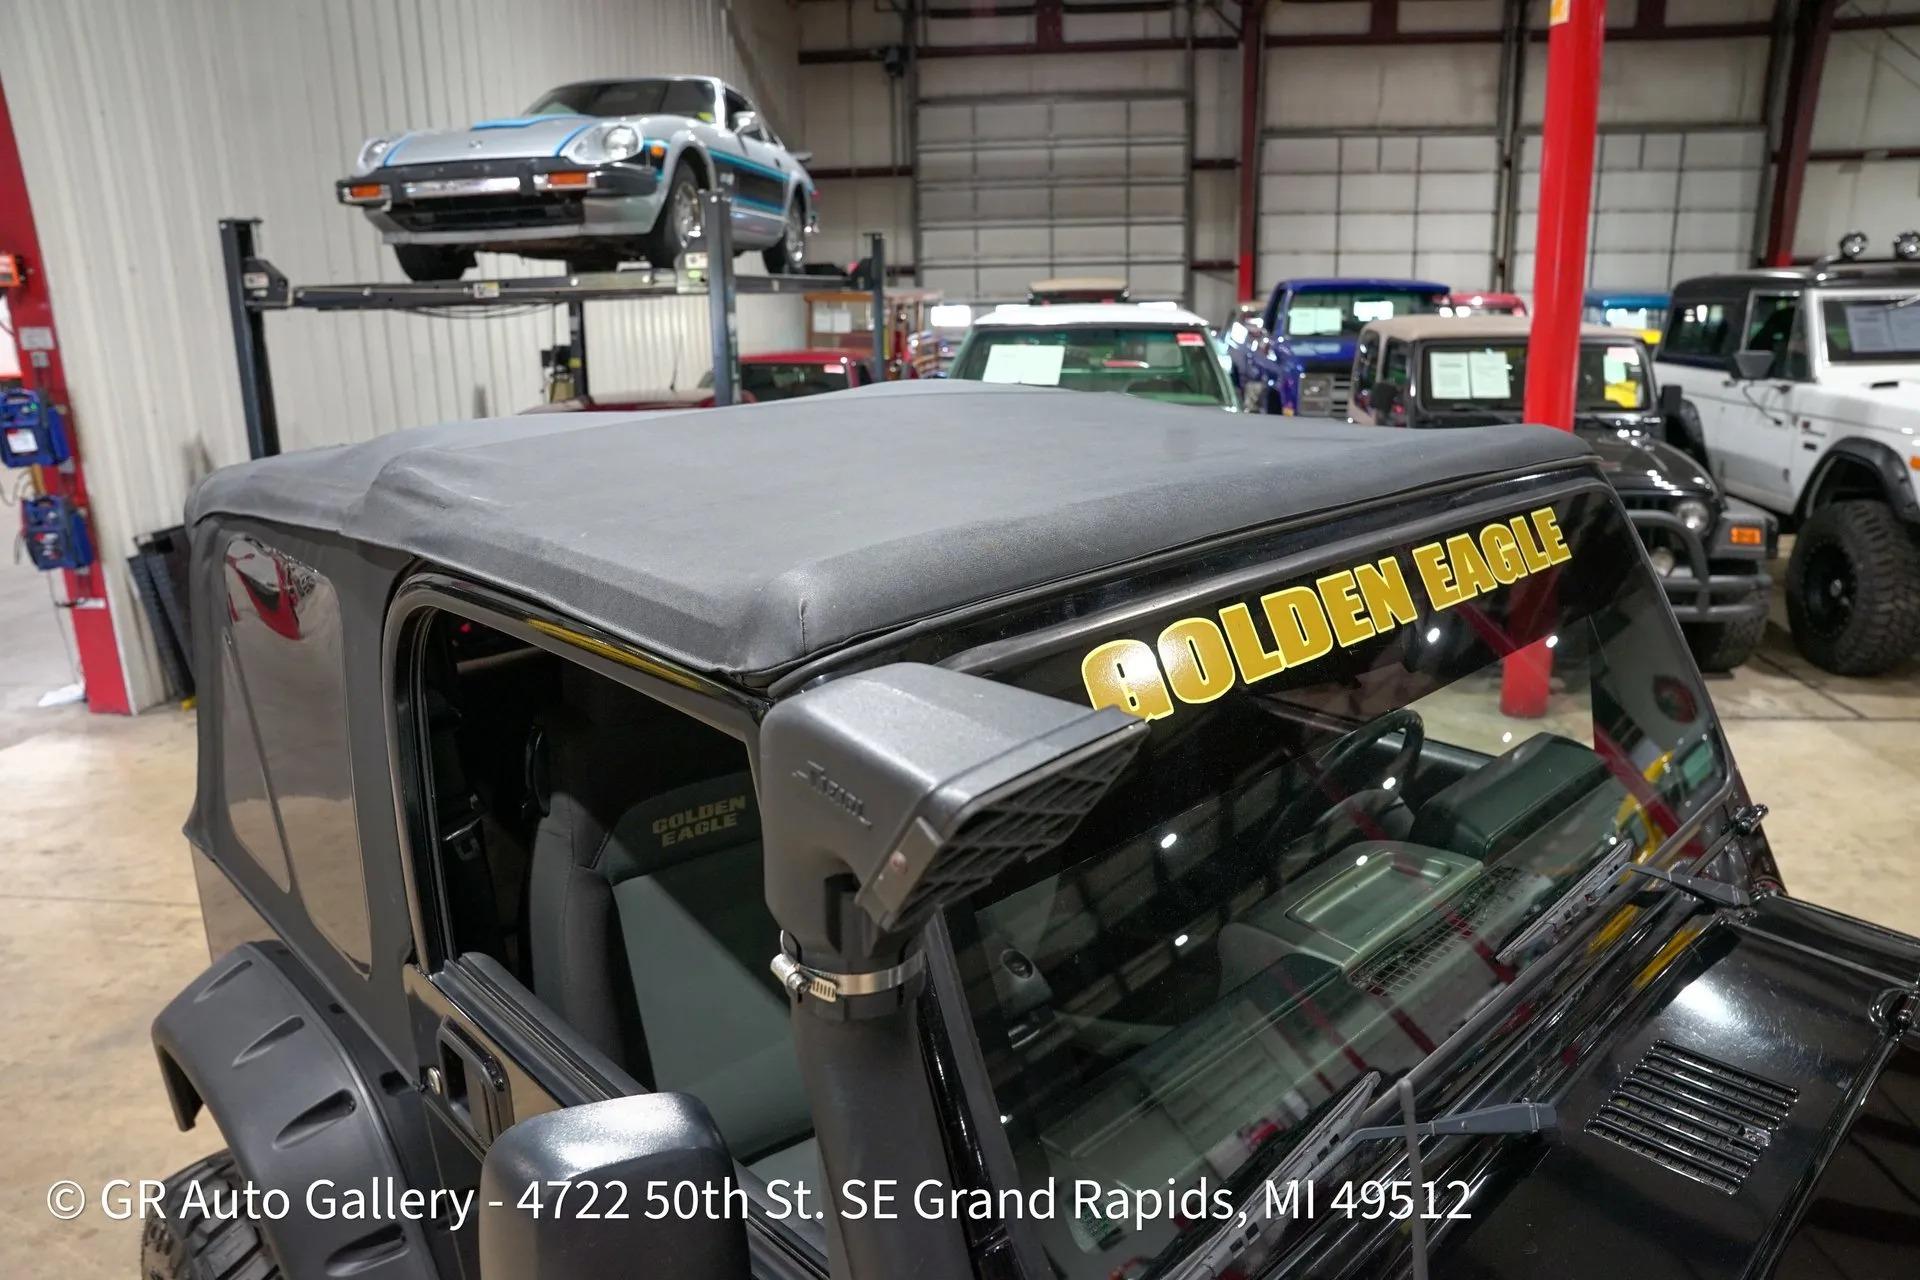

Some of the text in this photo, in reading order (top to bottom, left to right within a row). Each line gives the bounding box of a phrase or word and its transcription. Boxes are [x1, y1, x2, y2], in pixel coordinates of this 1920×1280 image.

[1081, 506, 1573, 722] GOLDEN EAGLE
[652, 795, 746, 834] GOLDEN
[661, 812, 737, 848] EAGLE
